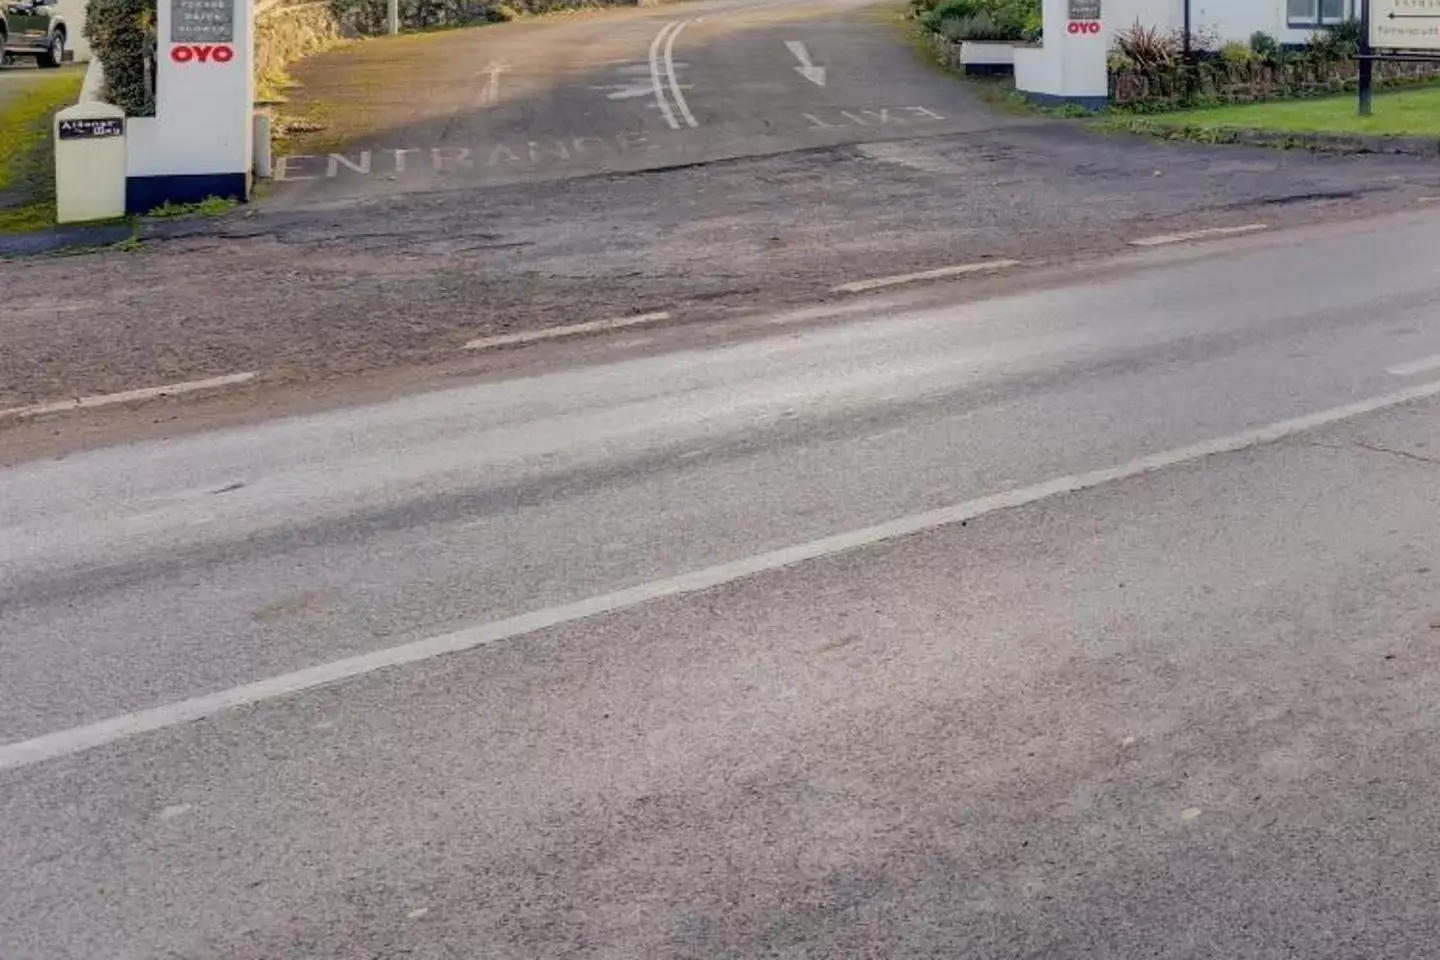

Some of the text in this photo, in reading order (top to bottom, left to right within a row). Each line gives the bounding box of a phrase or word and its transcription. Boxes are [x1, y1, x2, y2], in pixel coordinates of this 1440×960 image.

[1067, 22, 1100, 34] OYO
[171, 45, 233, 63] OYO
[274, 128, 650, 181] ENTRANCE
